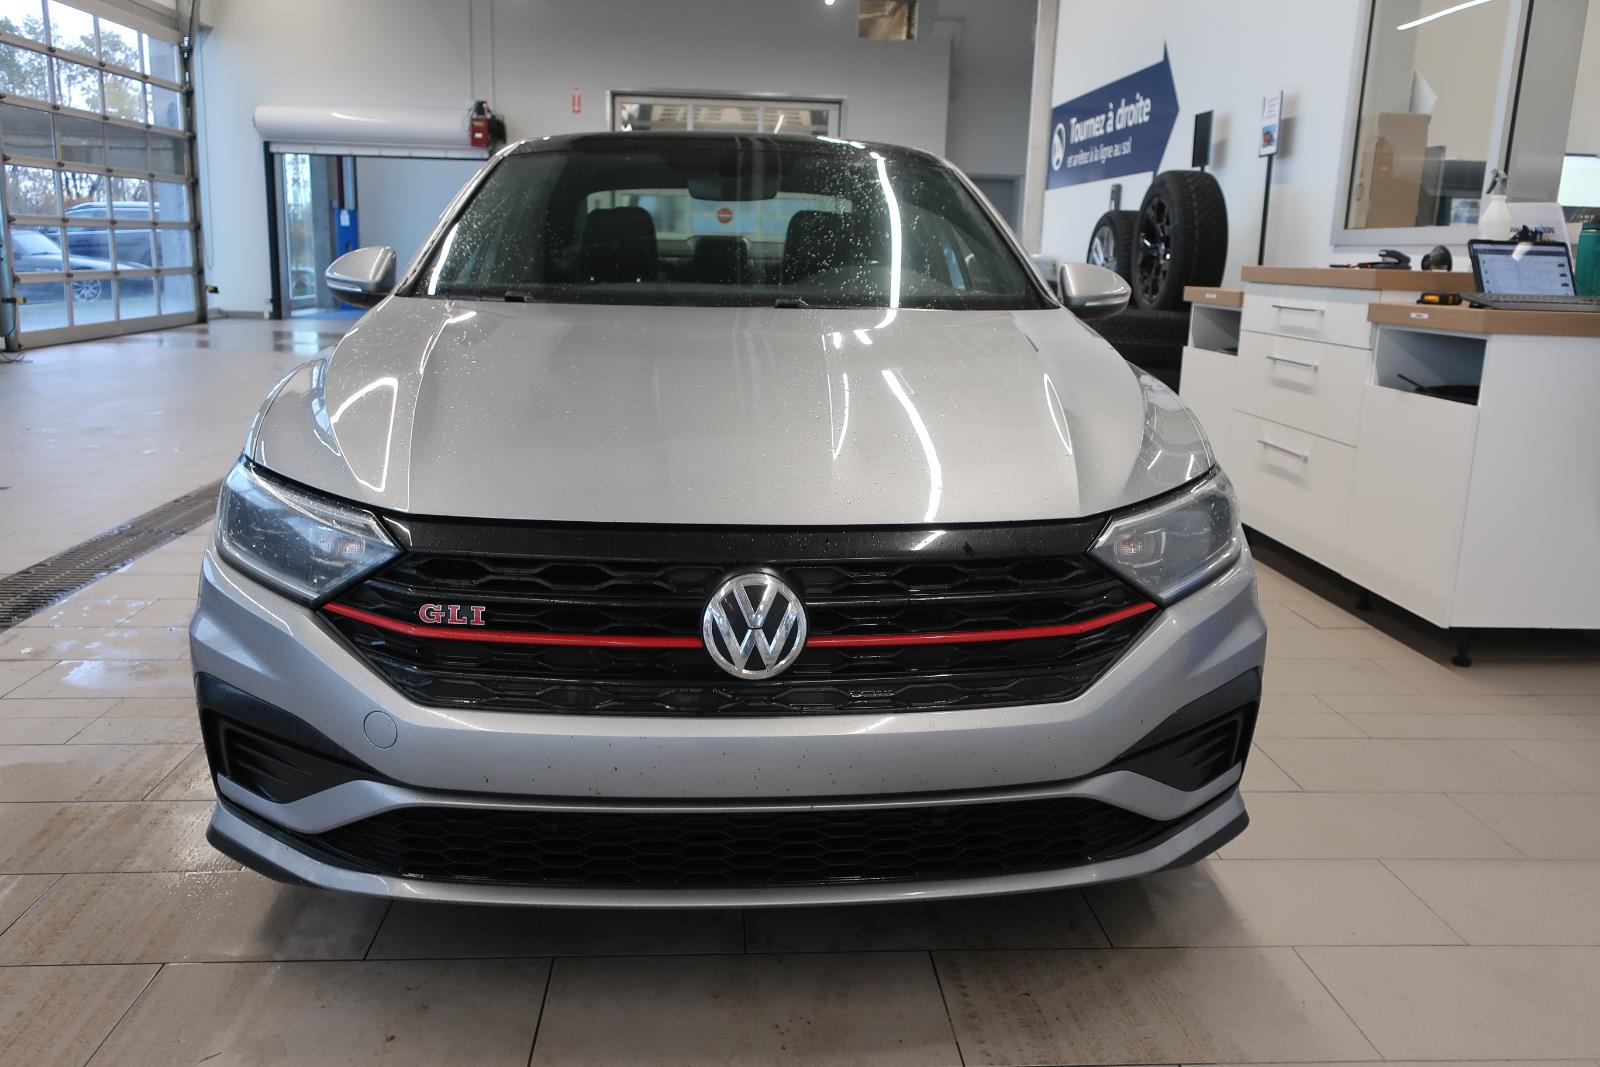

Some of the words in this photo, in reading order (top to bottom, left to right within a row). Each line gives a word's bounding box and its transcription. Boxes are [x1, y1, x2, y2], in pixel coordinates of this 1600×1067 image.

[1070, 114, 1106, 144] Tournez
[1106, 102, 1115, 133] à
[1115, 92, 1152, 130] droite
[1122, 136, 1133, 155] sol
[419, 603, 486, 626] GLI
